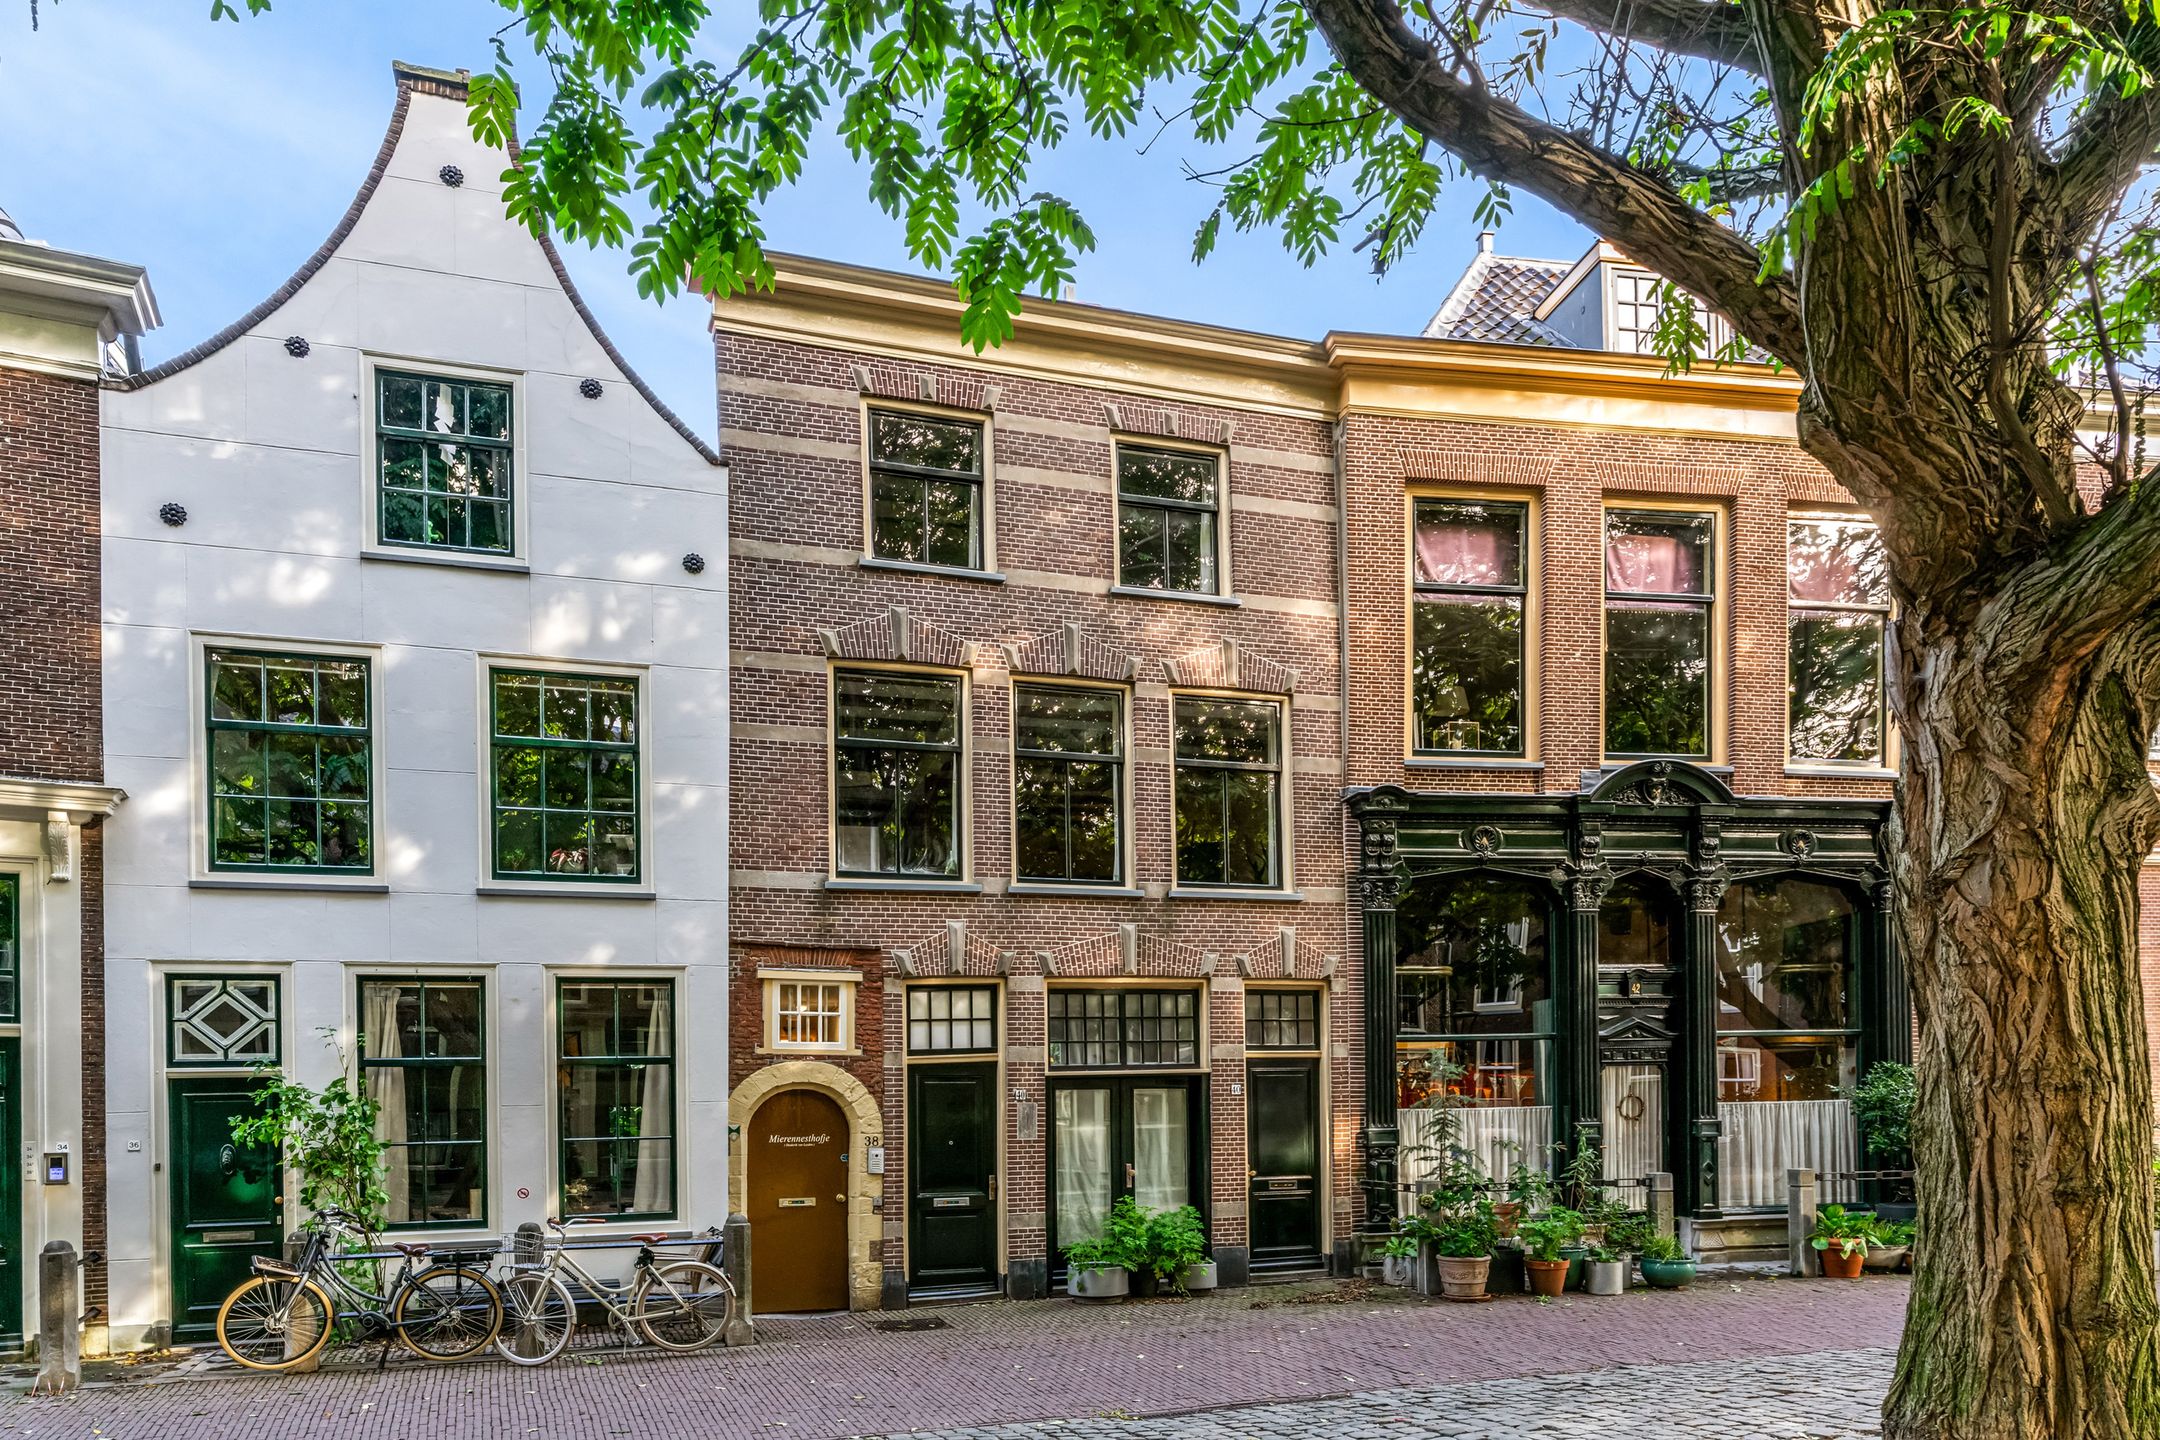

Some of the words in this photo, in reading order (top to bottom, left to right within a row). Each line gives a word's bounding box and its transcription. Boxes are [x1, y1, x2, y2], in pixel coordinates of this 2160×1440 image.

[1632, 983, 1641, 994] 42
[768, 1133, 831, 1144] Mierennesthofje
[864, 1135, 879, 1147] 38
[57, 1143, 68, 1151] 34
[128, 1141, 140, 1149] 36
